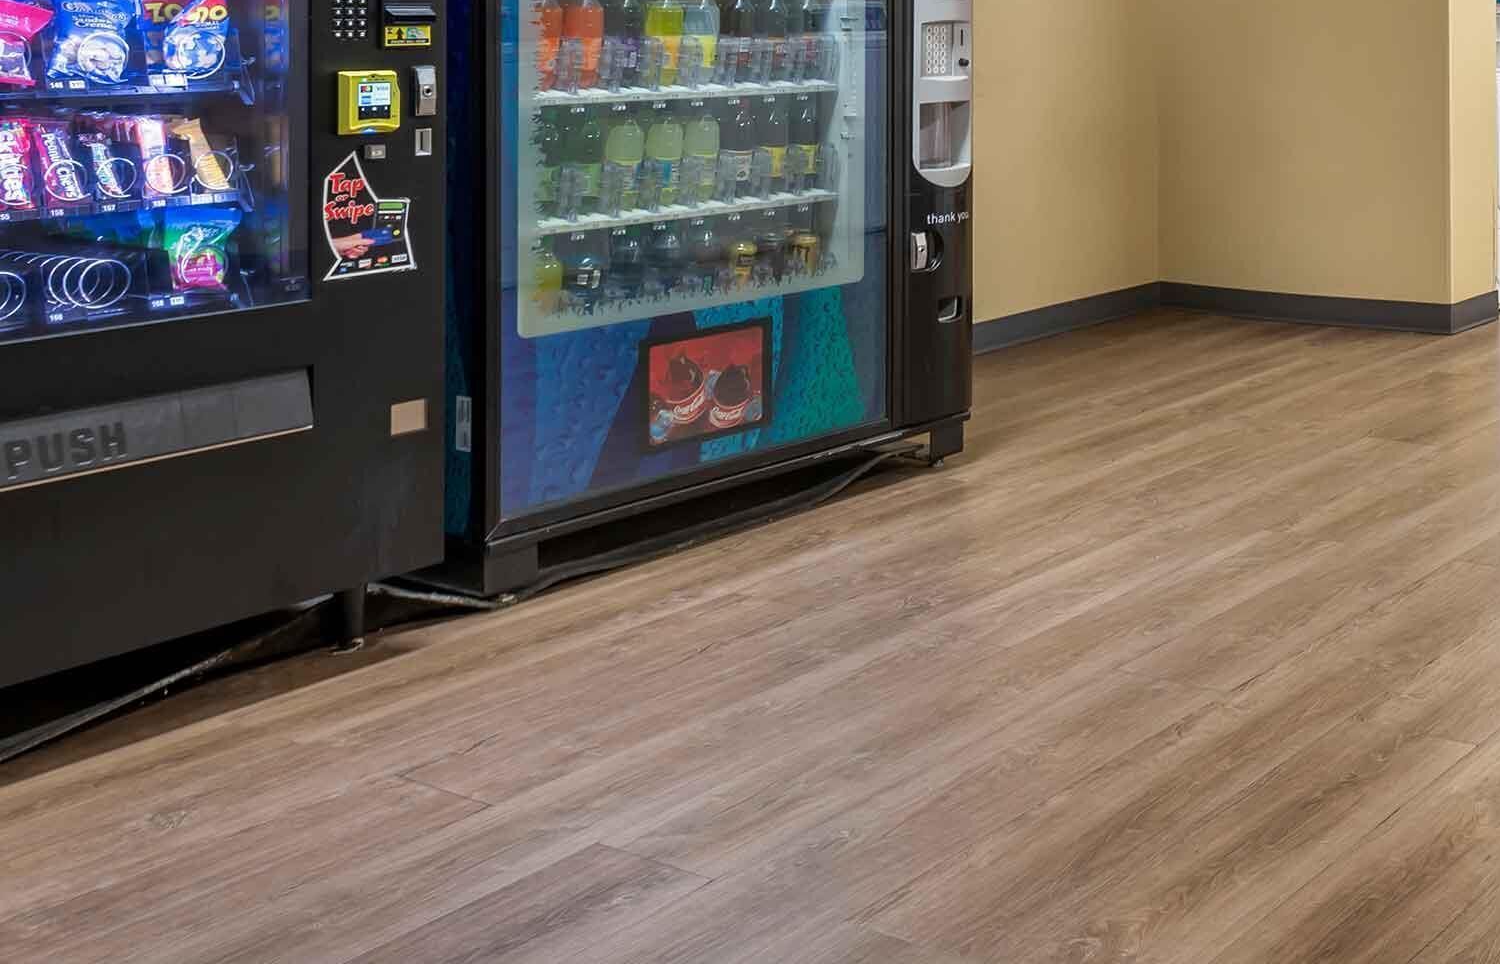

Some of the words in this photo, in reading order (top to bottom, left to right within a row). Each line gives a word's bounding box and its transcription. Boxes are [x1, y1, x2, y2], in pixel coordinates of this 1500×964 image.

[329, 172, 364, 198] Tap
[335, 194, 349, 202] or
[324, 200, 374, 225] Swipe
[927, 212, 955, 224] thank
[4, 422, 127, 479] PUSH
